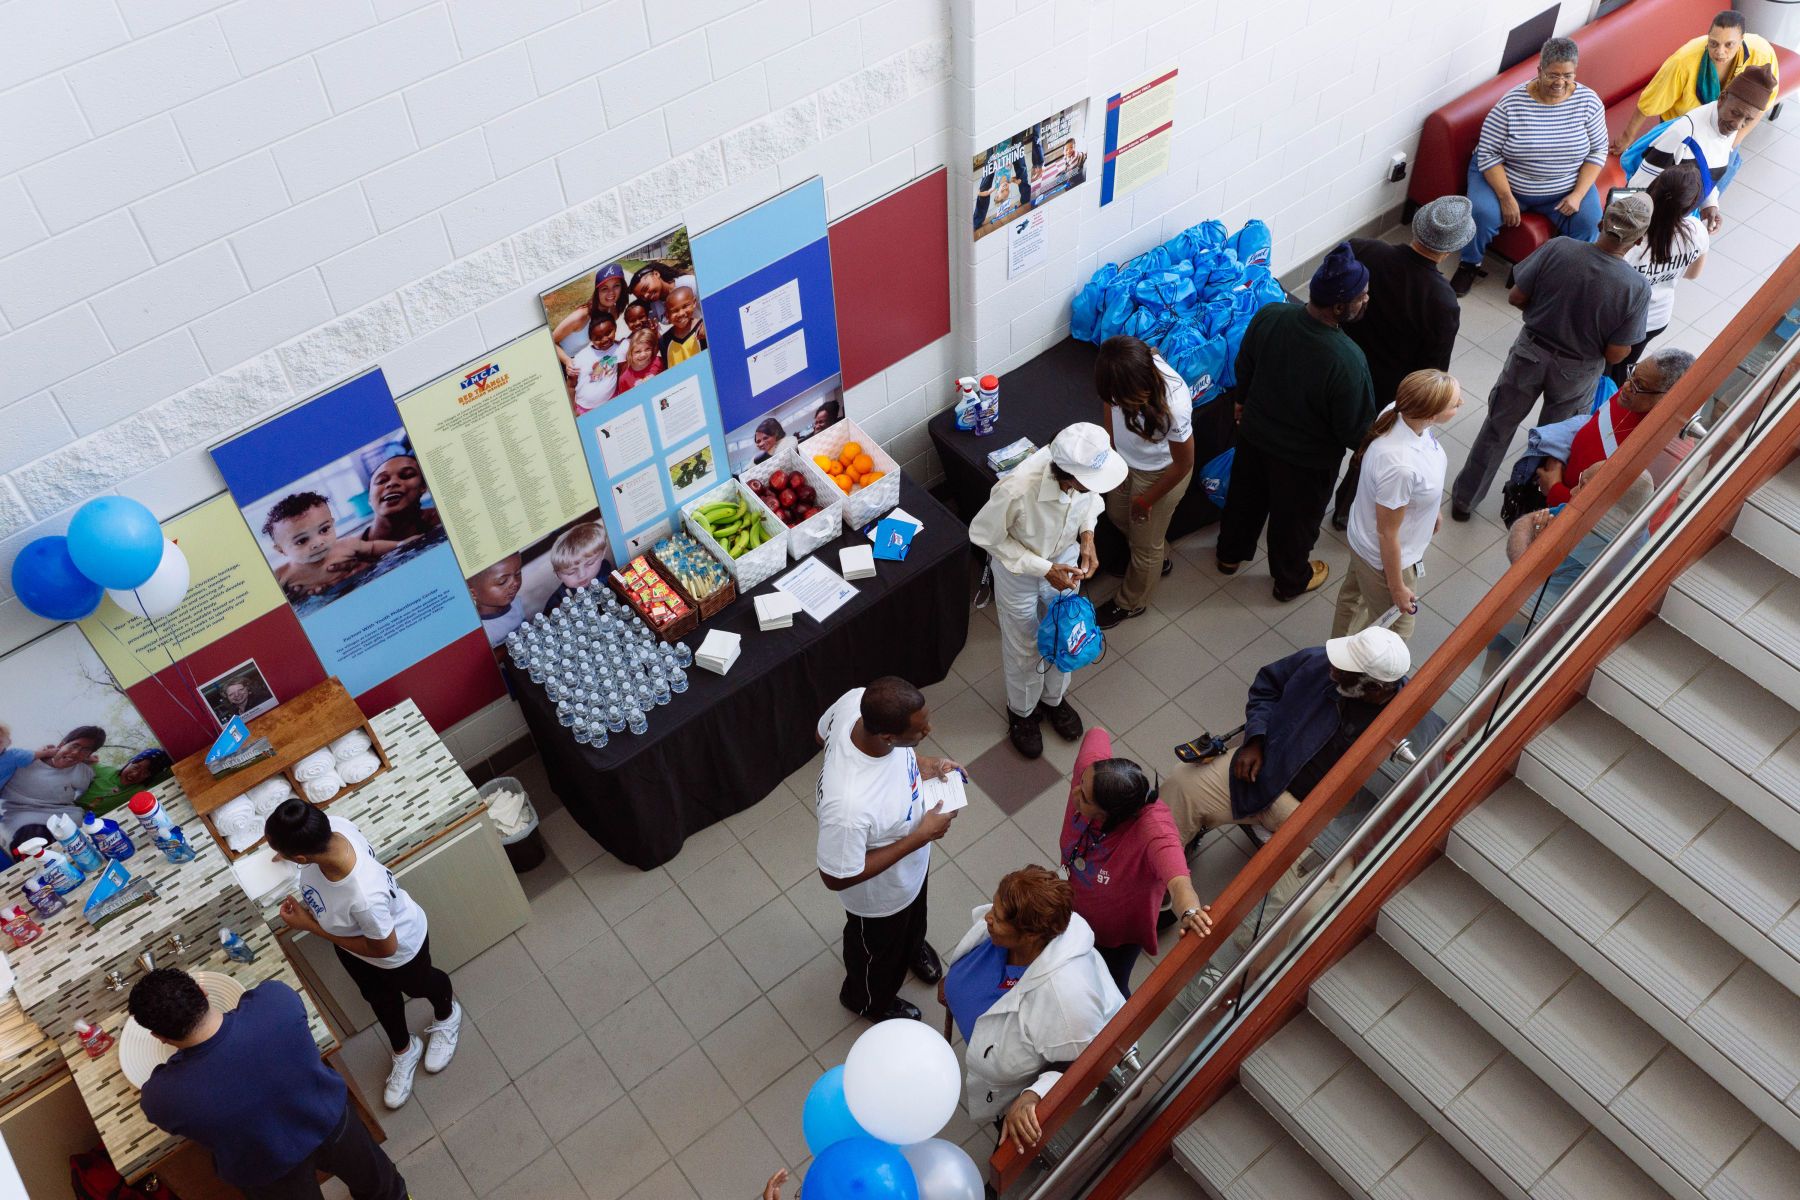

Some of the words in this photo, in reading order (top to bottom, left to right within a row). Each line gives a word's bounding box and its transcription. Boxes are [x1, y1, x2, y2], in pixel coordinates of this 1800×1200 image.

[1141, 84, 1152, 92] YMCA
[982, 145, 1024, 178] HEALTHING
[1634, 250, 1699, 277] EALTHING
[462, 366, 496, 387] YMCA
[1191, 374, 1210, 395] Lysol
[458, 392, 473, 403] RED
[187, 576, 217, 593] eo-Christian
[182, 588, 207, 602] olunteers,
[362, 624, 374, 632] With
[376, 615, 390, 624] Youth
[157, 638, 173, 647] YMCA
[67, 837, 83, 854] Lysol
[101, 833, 119, 848] Lysol
[1097, 874, 1110, 885] 97
[302, 889, 325, 918] Lysol
